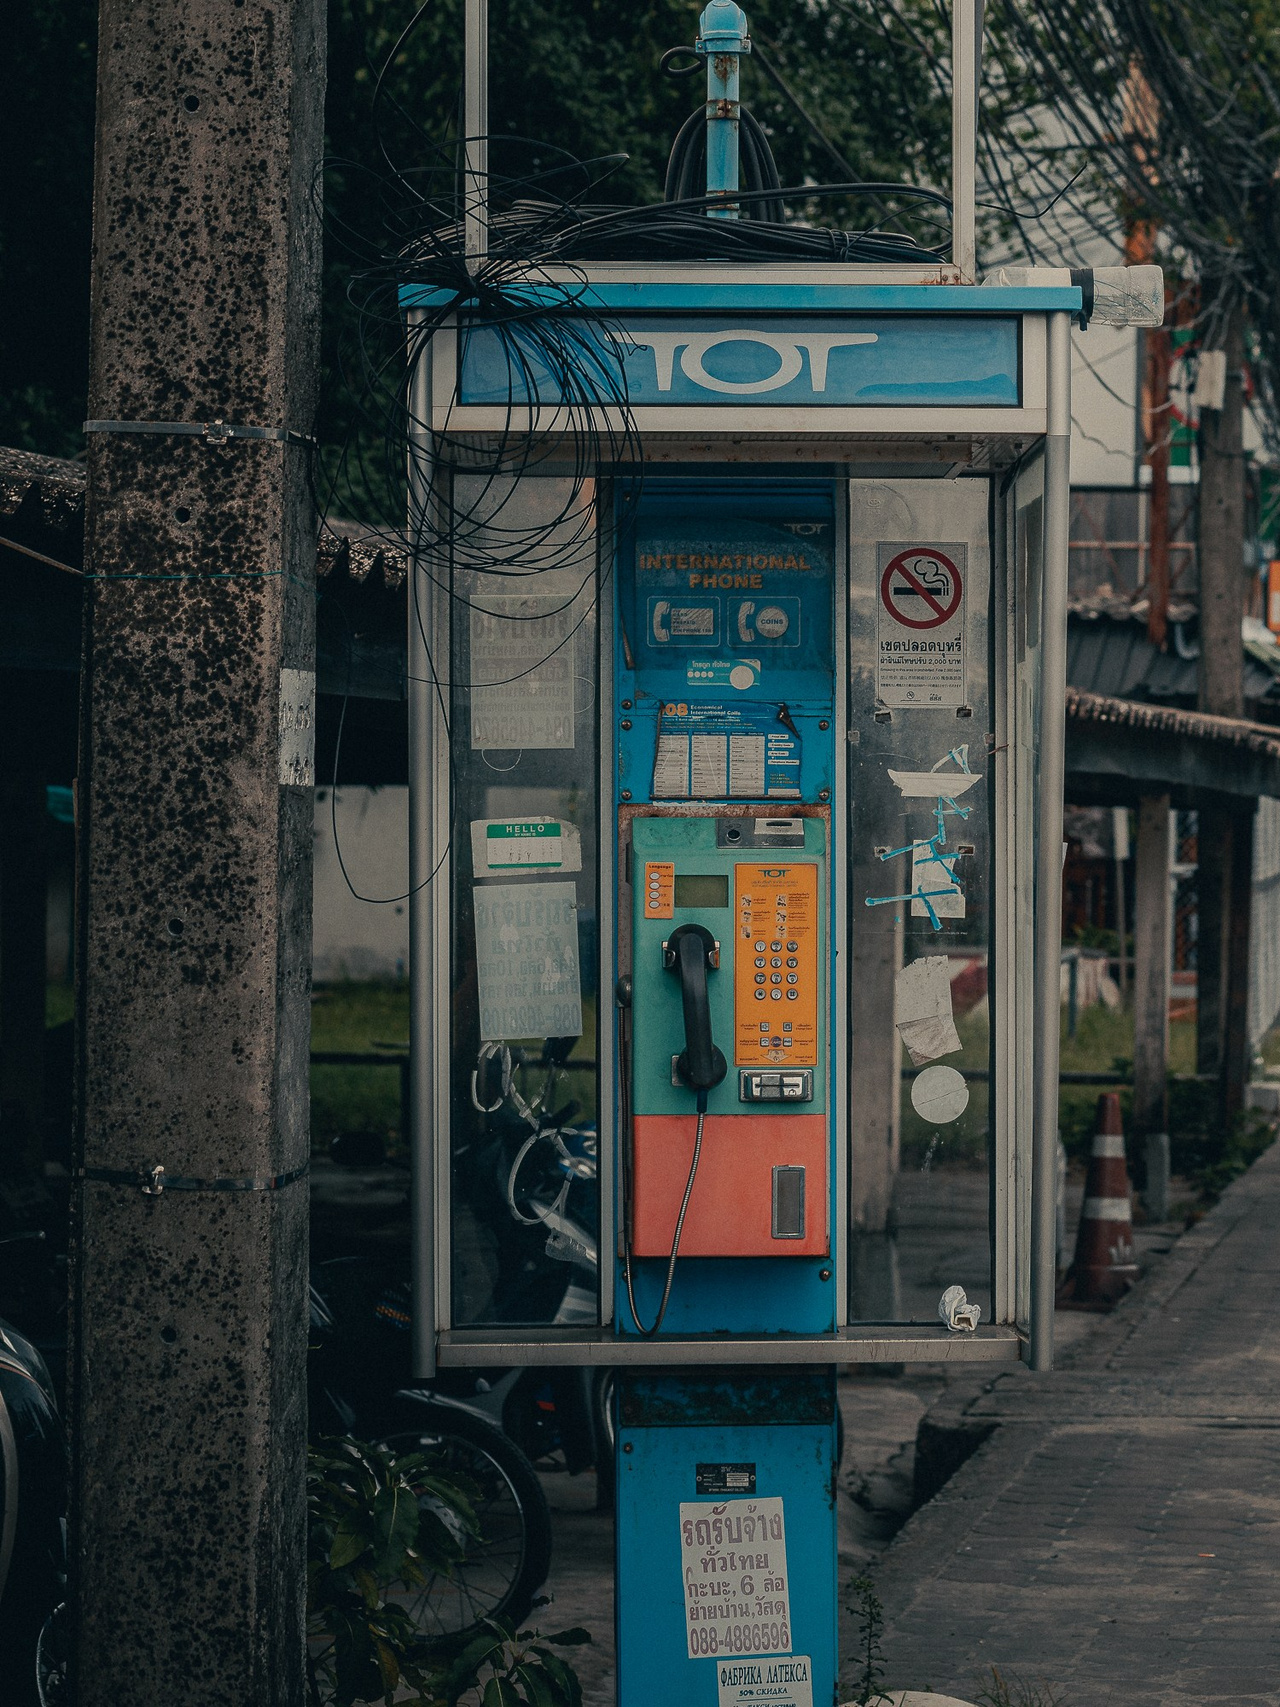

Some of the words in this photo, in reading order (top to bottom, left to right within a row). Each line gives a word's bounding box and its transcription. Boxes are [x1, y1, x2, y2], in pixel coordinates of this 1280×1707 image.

[605, 329, 878, 394] TOT
[783, 523, 829, 535] TOT
[639, 553, 811, 571] INTERNATIONAL
[689, 573, 763, 589] PHONE
[880, 633, 961, 658] เขตปลอดบุหรี่
[506, 825, 545, 833] HELLO
[758, 869, 792, 878] TOT
[682, 1504, 782, 1546] รถรับจ้าง
[700, 1546, 769, 1573] ทั่วไทย
[740, 1575, 755, 1595] 6
[764, 1570, 785, 1592] ล้อ
[690, 1596, 787, 1621] ย้ายบ้าน,วัสดุ
[690, 1621, 789, 1655] 088-4886596
[721, 1666, 762, 1687] ФАБРИКА
[766, 1663, 808, 1683] ЛАТЕКСА
[756, 1687, 788, 1696] СКИДКА
